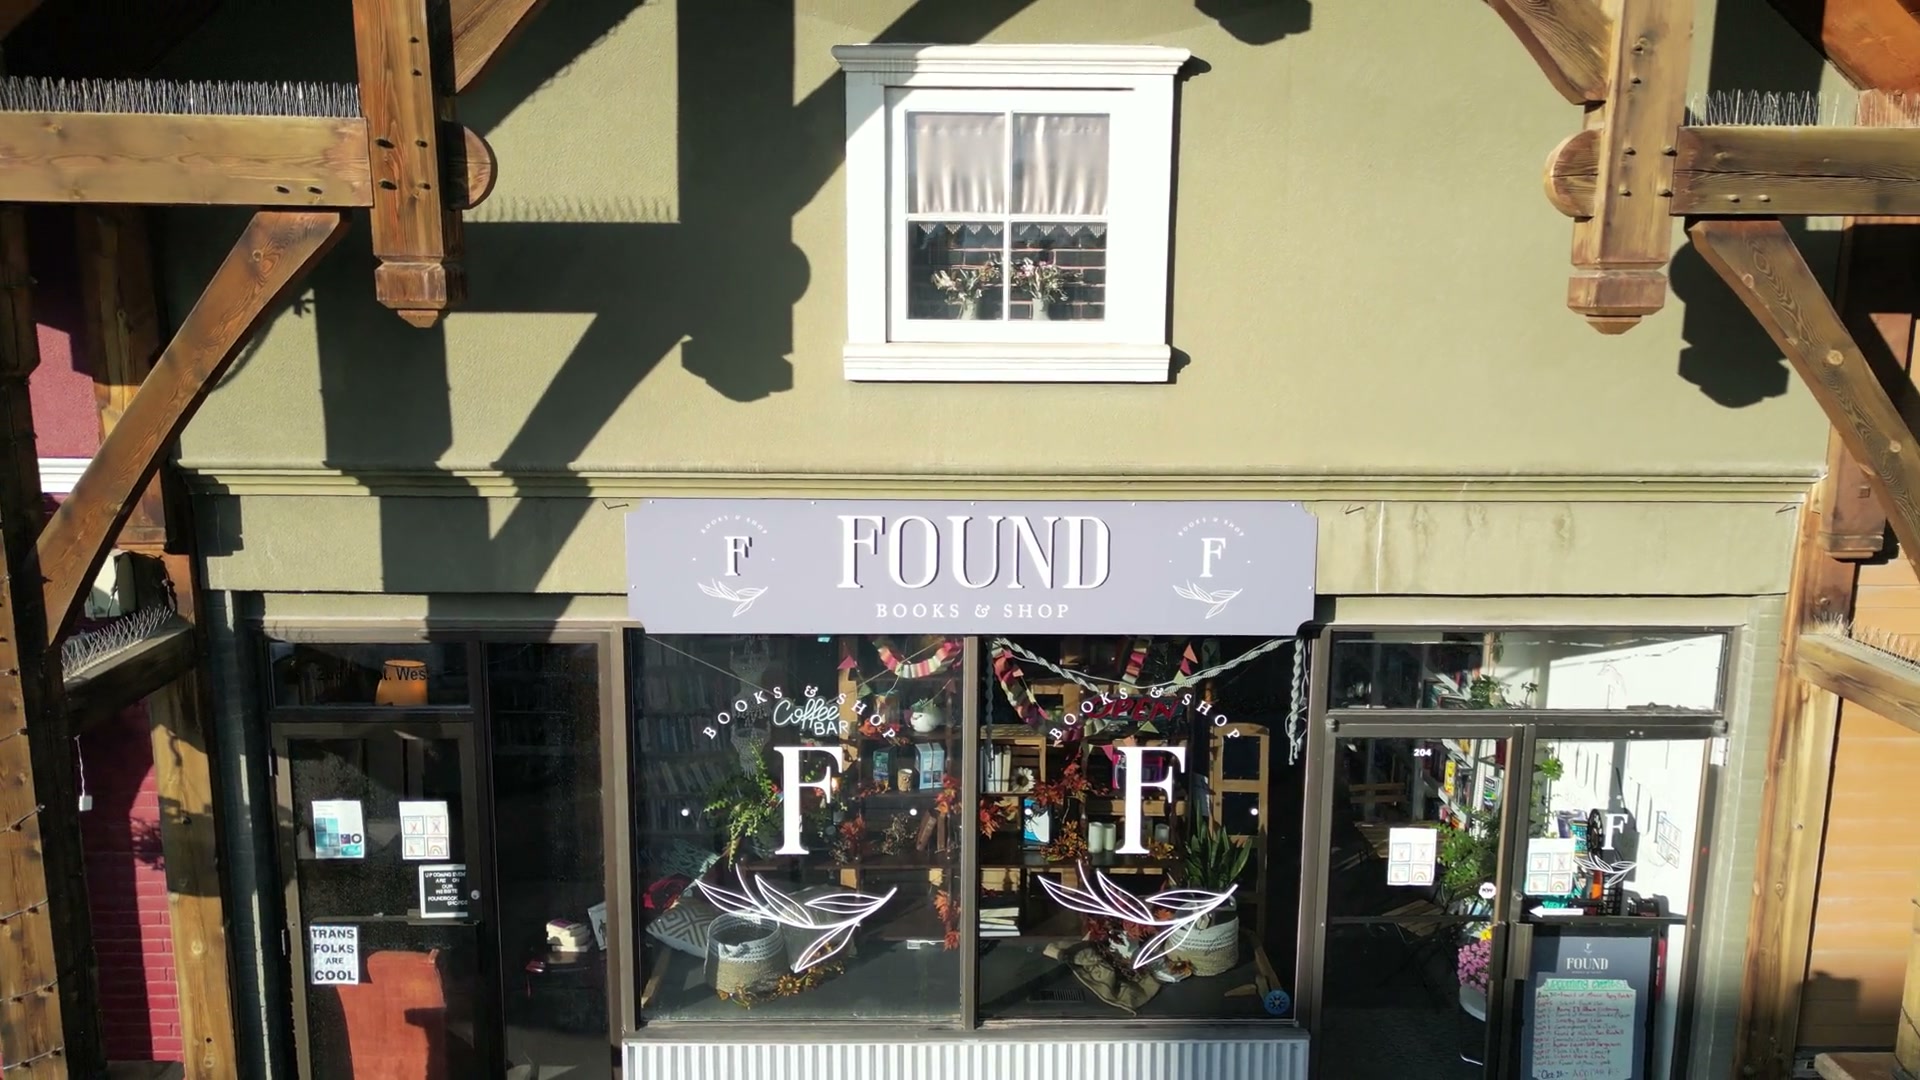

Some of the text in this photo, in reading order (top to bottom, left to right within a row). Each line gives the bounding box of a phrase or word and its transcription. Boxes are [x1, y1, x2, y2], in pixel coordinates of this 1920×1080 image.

[724, 536, 753, 576] F
[837, 515, 1111, 589] FOUND
[1199, 537, 1226, 578] F
[876, 603, 1070, 618] BOOKS & SHOP
[703, 685, 897, 740] BOOKS & SHOP
[773, 697, 841, 729] Coffee
[1049, 686, 1240, 740] BOOKS & SHOP
[1085, 697, 1181, 722] OPEN
[813, 720, 849, 736] BAR
[1413, 748, 1432, 757] 204
[773, 746, 843, 855] F
[1115, 746, 1186, 855] F
[1602, 813, 1629, 850] F
[312, 929, 355, 939] TRANS
[314, 944, 355, 954] FOLKS
[326, 957, 344, 965] ARE
[315, 970, 356, 981] COOL
[1566, 957, 1609, 970] FOUND
